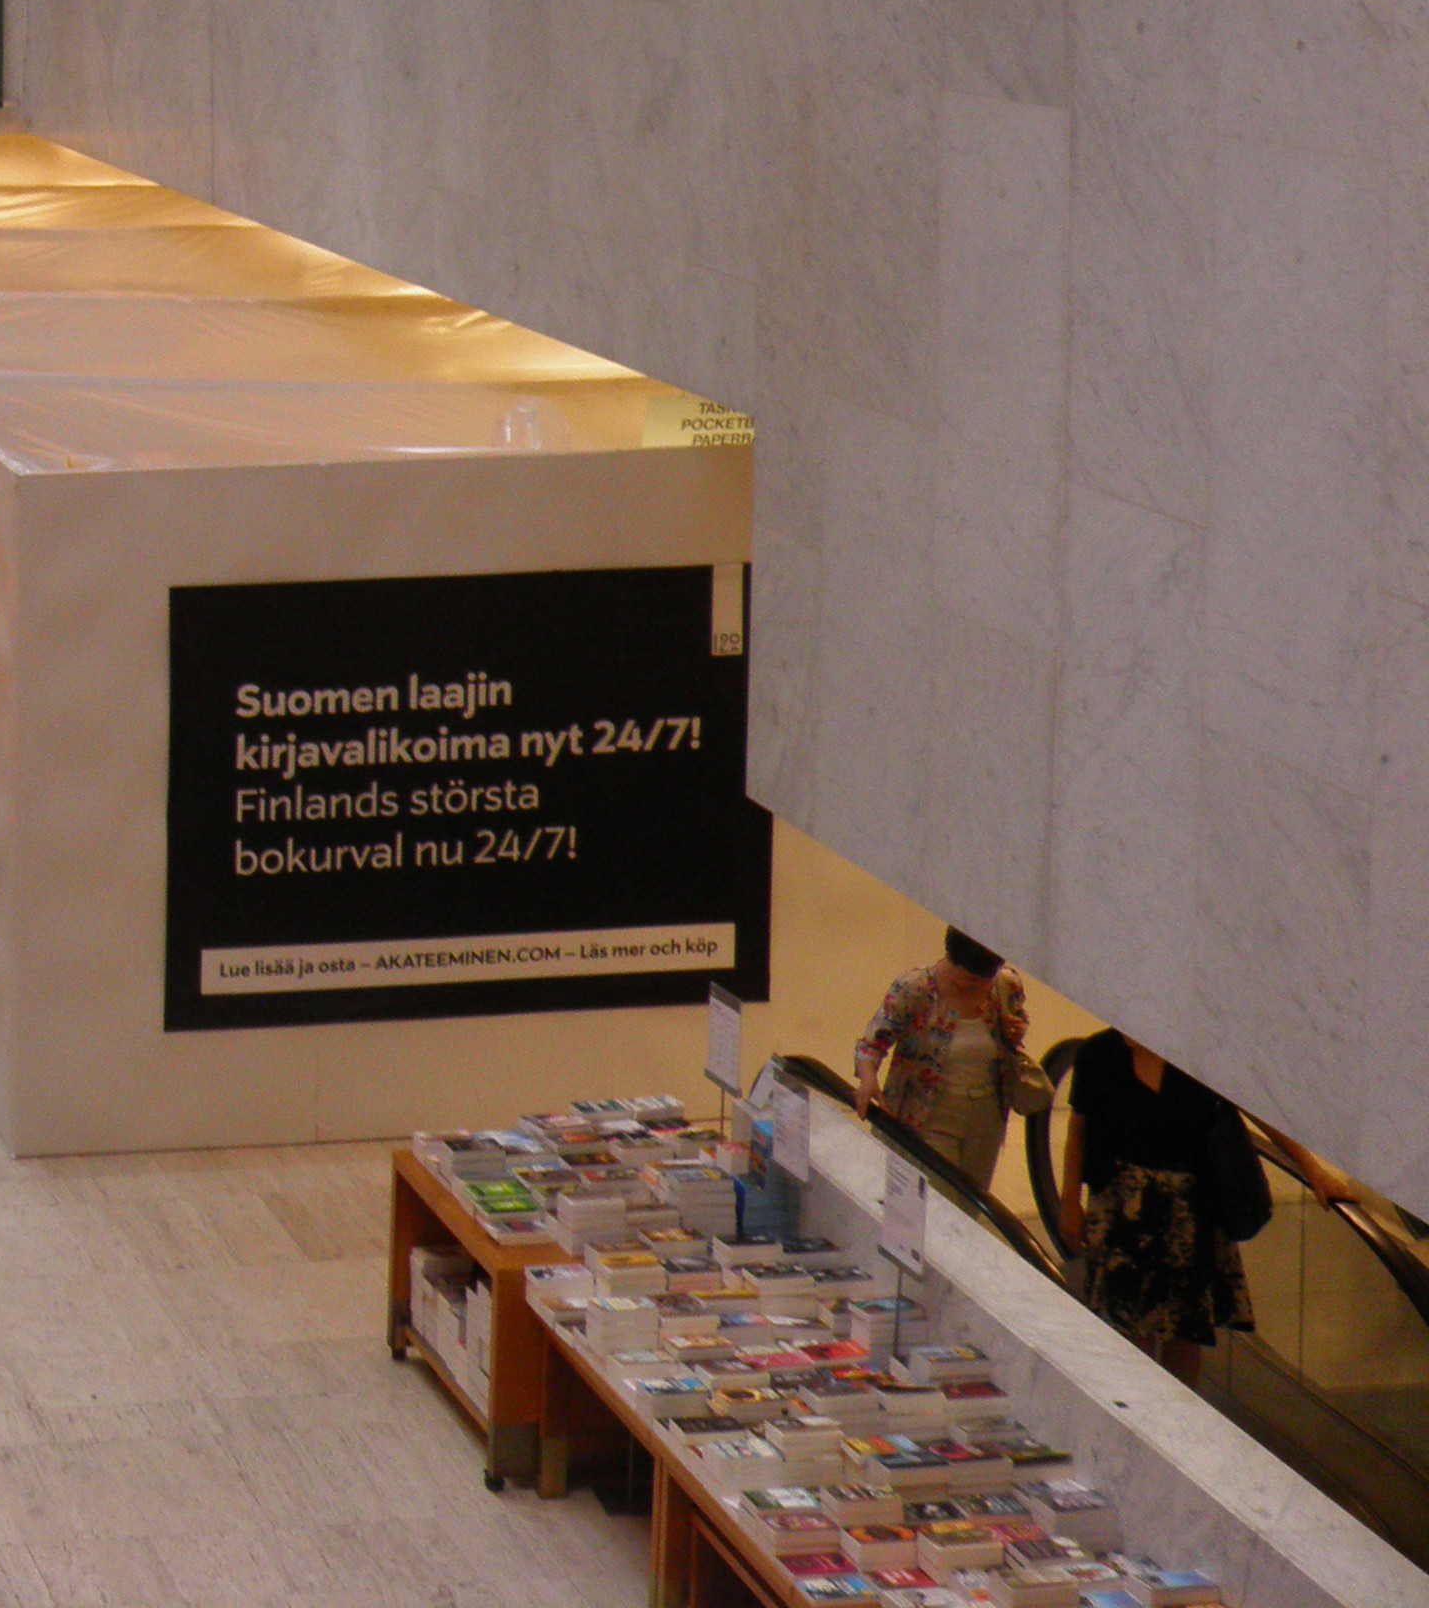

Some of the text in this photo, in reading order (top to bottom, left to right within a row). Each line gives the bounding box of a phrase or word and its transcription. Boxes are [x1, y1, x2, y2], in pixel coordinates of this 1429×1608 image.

[236, 672, 512, 719] Suomen laajin
[236, 717, 701, 779] kirjavalikoima nyt 24/7!
[236, 779, 540, 822] Finlands största
[235, 827, 577, 875] bokurval nu 24/7!
[219, 961, 251, 978] Lue
[255, 959, 295, 977] lisää
[297, 958, 314, 979] ja
[318, 959, 356, 975] osta
[374, 947, 561, 971] AKATEEMINEN.COM
[579, 944, 608, 960] Läs
[612, 943, 647, 957] mer
[649, 939, 681, 956] och
[685, 937, 718, 958] köp
